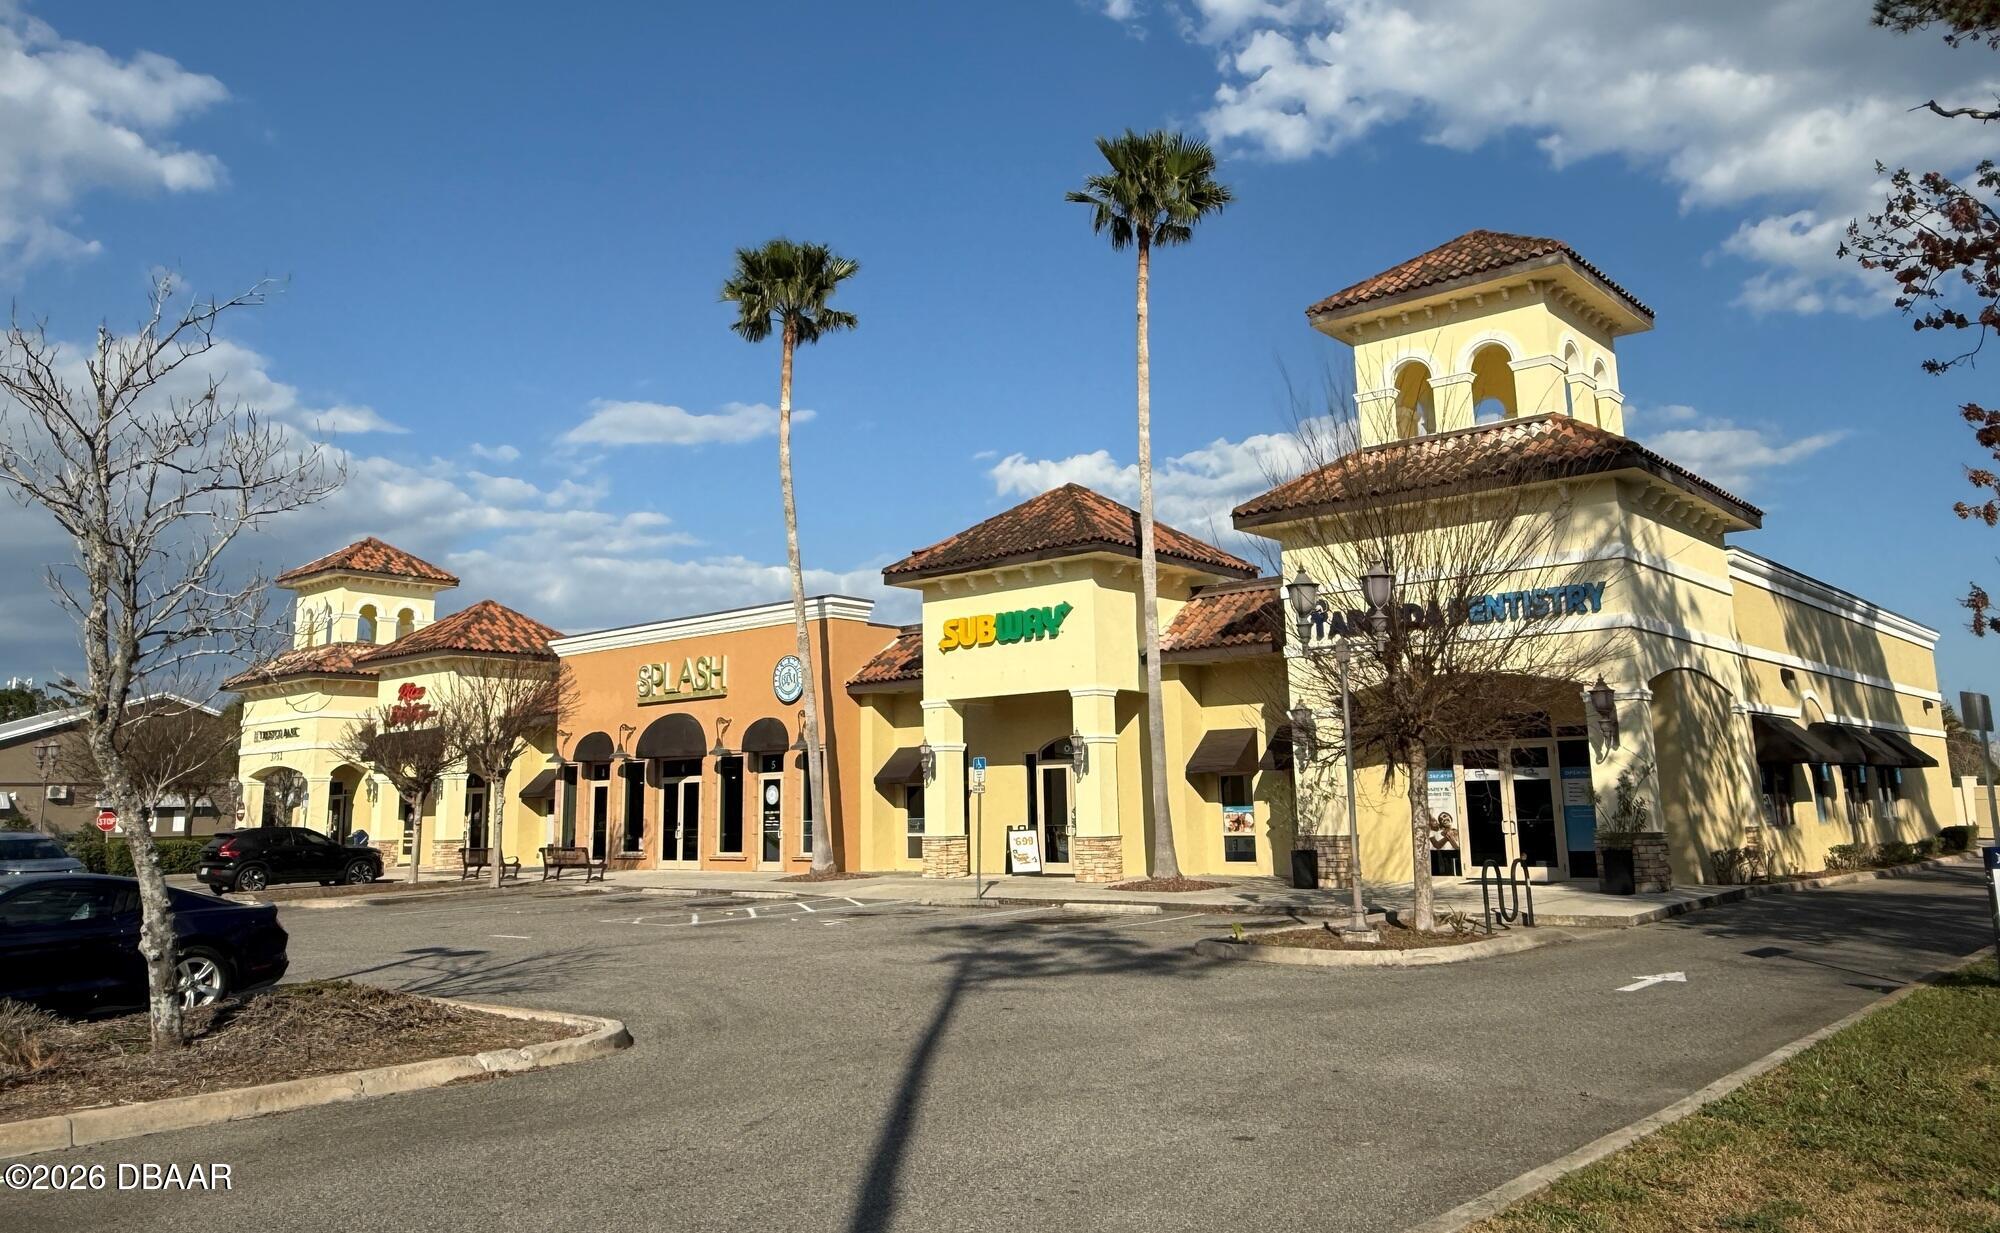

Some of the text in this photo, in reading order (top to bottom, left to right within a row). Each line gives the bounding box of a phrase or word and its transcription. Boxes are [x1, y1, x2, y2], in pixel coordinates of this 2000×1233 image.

[938, 600, 1074, 655] SUBWAY
[637, 655, 728, 698] SPLASH
[771, 760, 777, 770] 5
[98, 817, 116, 826] STOP
